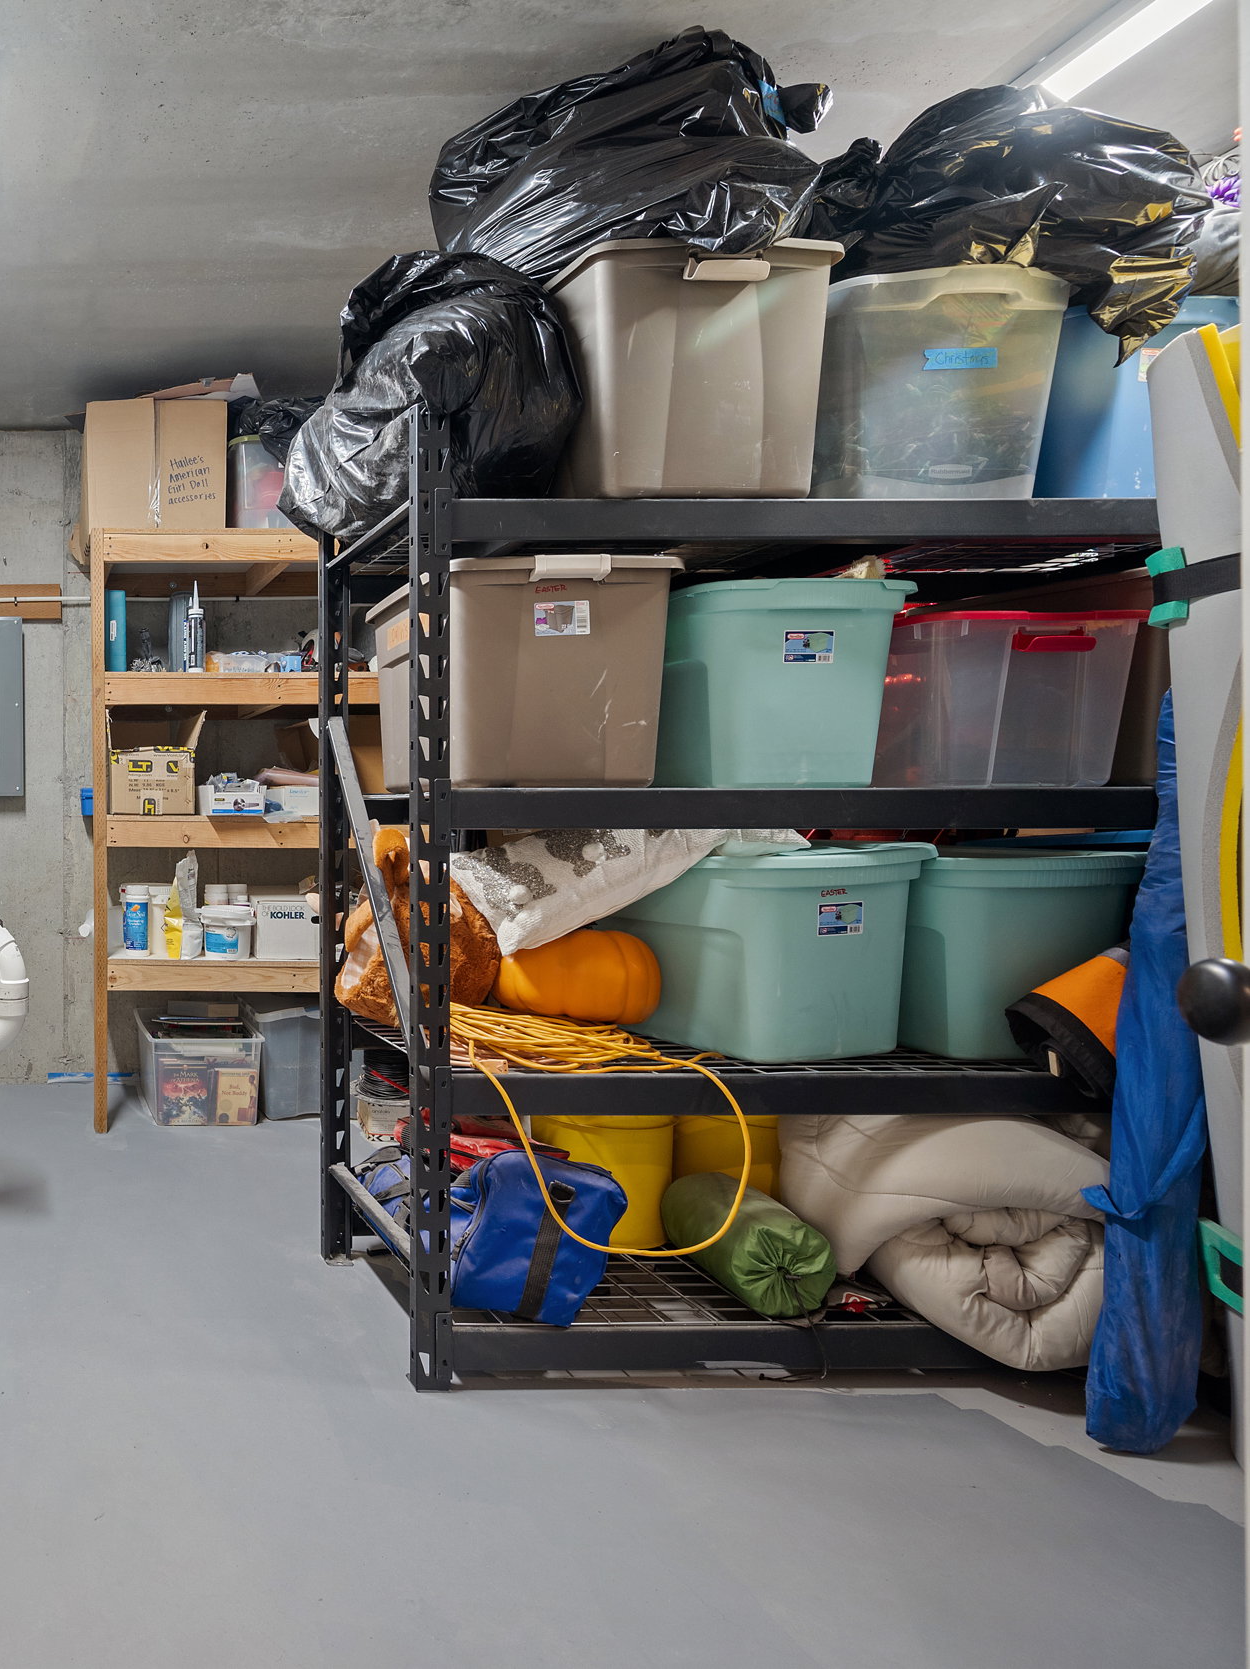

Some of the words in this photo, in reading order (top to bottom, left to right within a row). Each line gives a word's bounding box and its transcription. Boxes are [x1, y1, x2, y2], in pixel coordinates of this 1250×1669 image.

[170, 456, 204, 471] Hailee's
[169, 466, 210, 483] American
[167, 483, 186, 494] Girl
[189, 478, 209, 490] Doll
[168, 493, 216, 504] accessories
[535, 584, 567, 594] EASTER
[820, 888, 847, 897] EASTER
